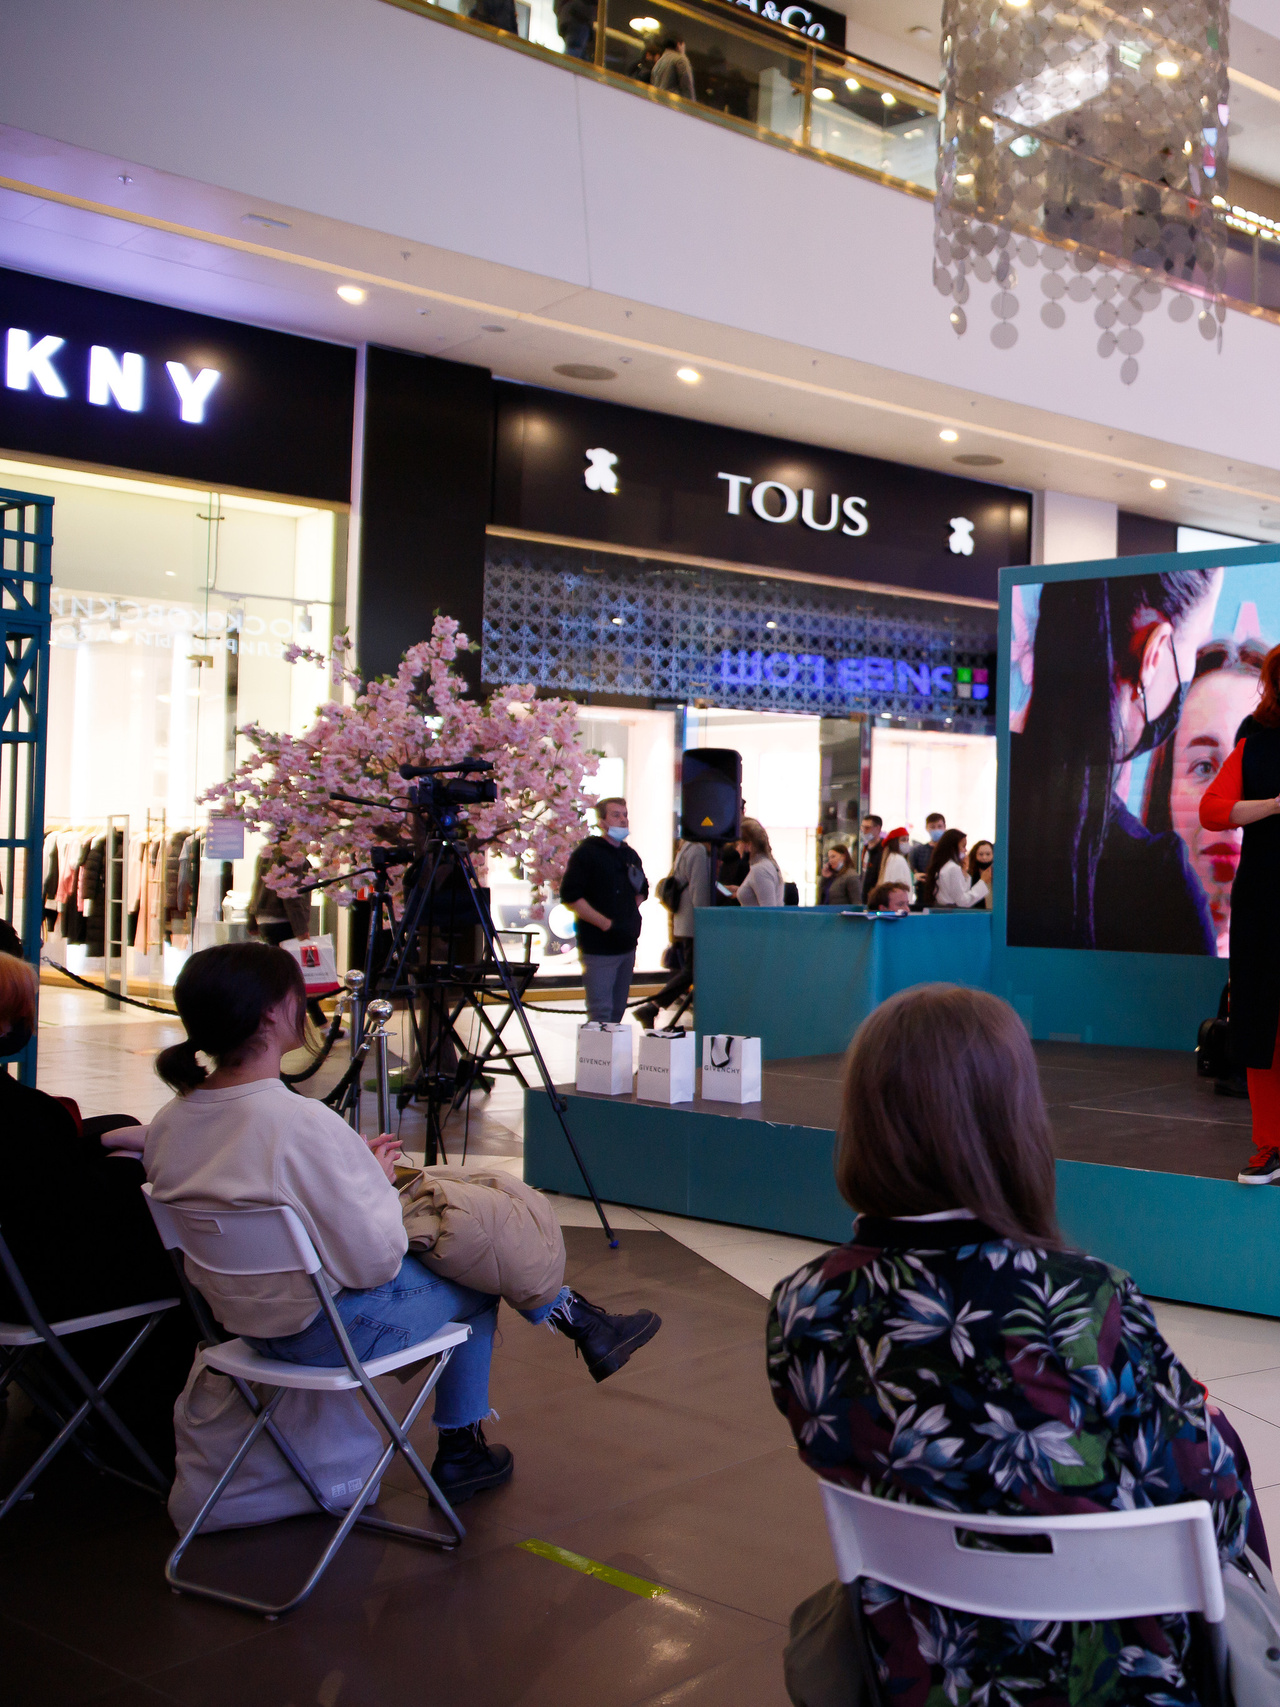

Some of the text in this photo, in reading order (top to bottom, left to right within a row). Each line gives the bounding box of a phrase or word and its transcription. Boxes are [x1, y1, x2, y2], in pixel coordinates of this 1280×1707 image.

[717, 471, 869, 537] TOUS
[578, 1056, 611, 1067] GIVENCHY
[638, 1064, 670, 1074] GIVENCHY
[704, 1064, 740, 1075] GIVENCHY
